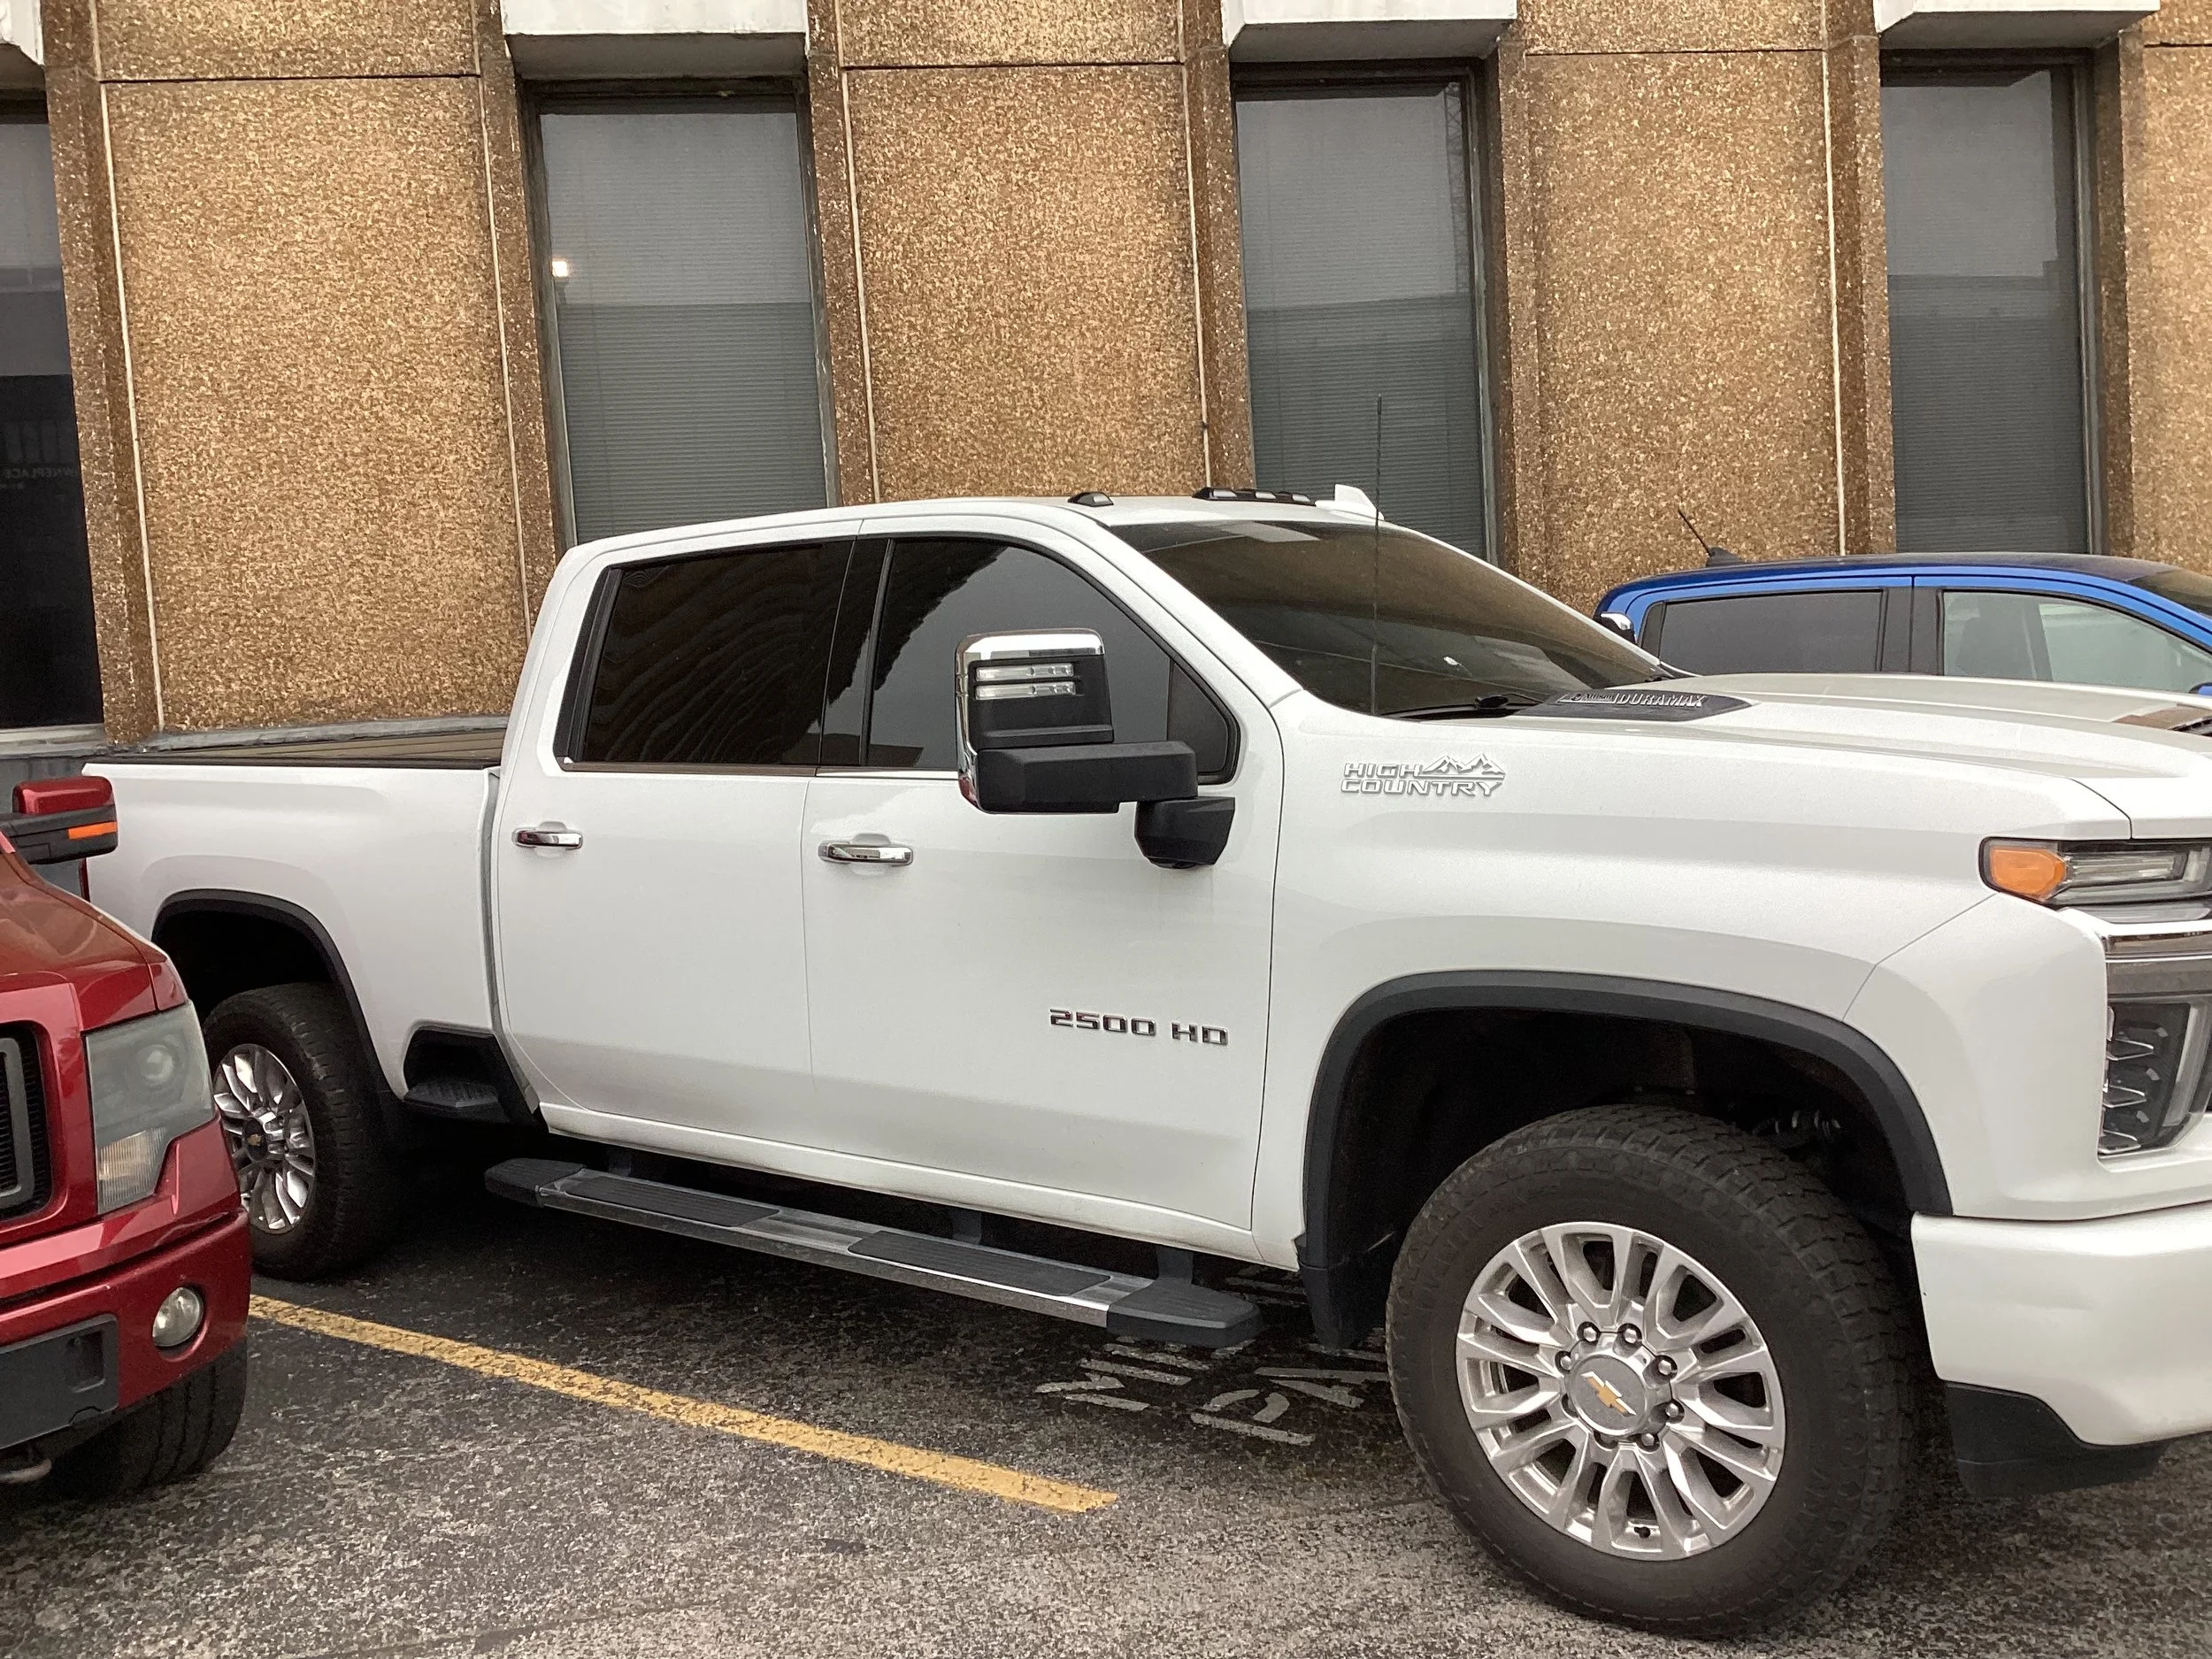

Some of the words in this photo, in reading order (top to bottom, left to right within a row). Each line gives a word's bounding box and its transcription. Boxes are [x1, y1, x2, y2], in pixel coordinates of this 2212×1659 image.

[1617, 694, 1706, 707] DURAMAX
[1343, 763, 1423, 778] HIGH
[1340, 779, 1503, 796] COUNTRY
[1049, 1009, 1156, 1036] 2500
[1171, 1023, 1228, 1046] HD
